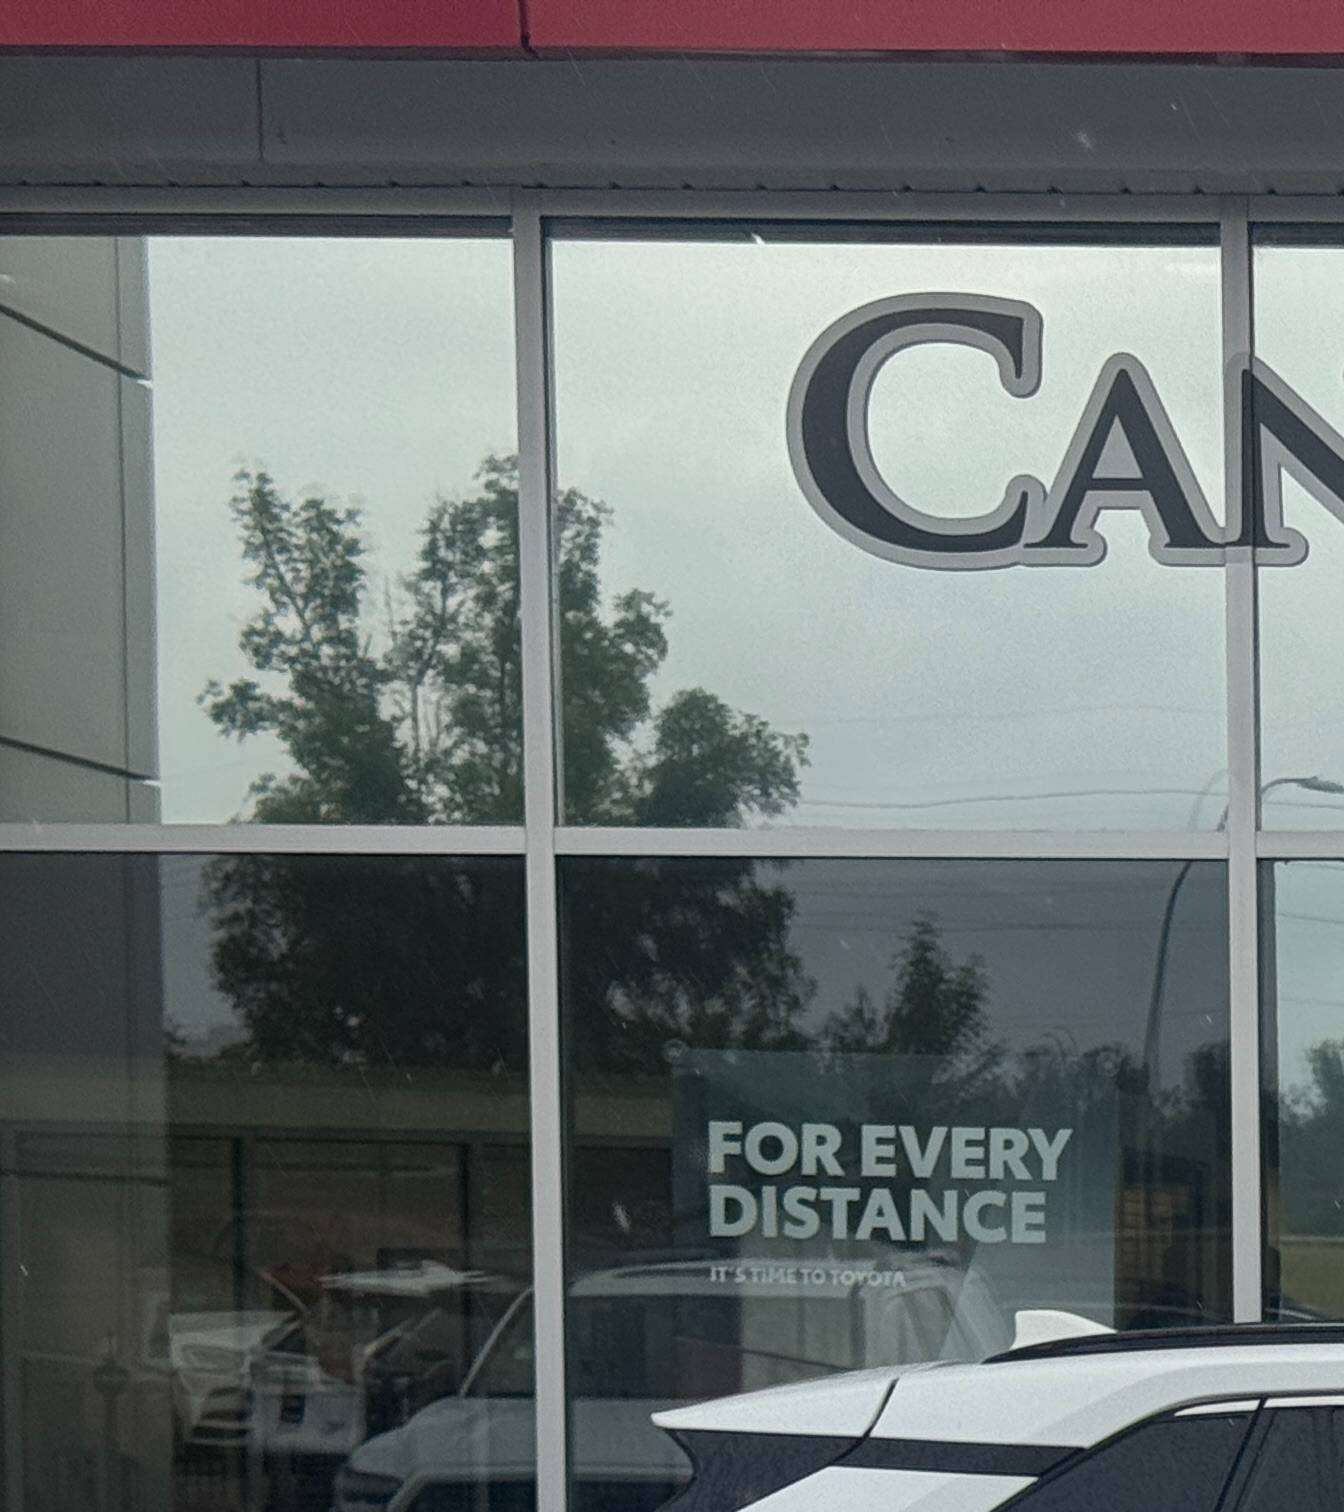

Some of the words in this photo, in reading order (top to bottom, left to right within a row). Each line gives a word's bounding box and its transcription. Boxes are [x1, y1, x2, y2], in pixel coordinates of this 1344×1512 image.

[707, 1120, 845, 1176] FOR
[860, 1124, 1073, 1181] EVERY
[708, 1184, 1048, 1244] DISTANCE
[709, 1266, 747, 1284] IT'S
[750, 1267, 798, 1285] TIME
[801, 1268, 826, 1285] TO
[830, 1269, 906, 1288] TOYOTA
